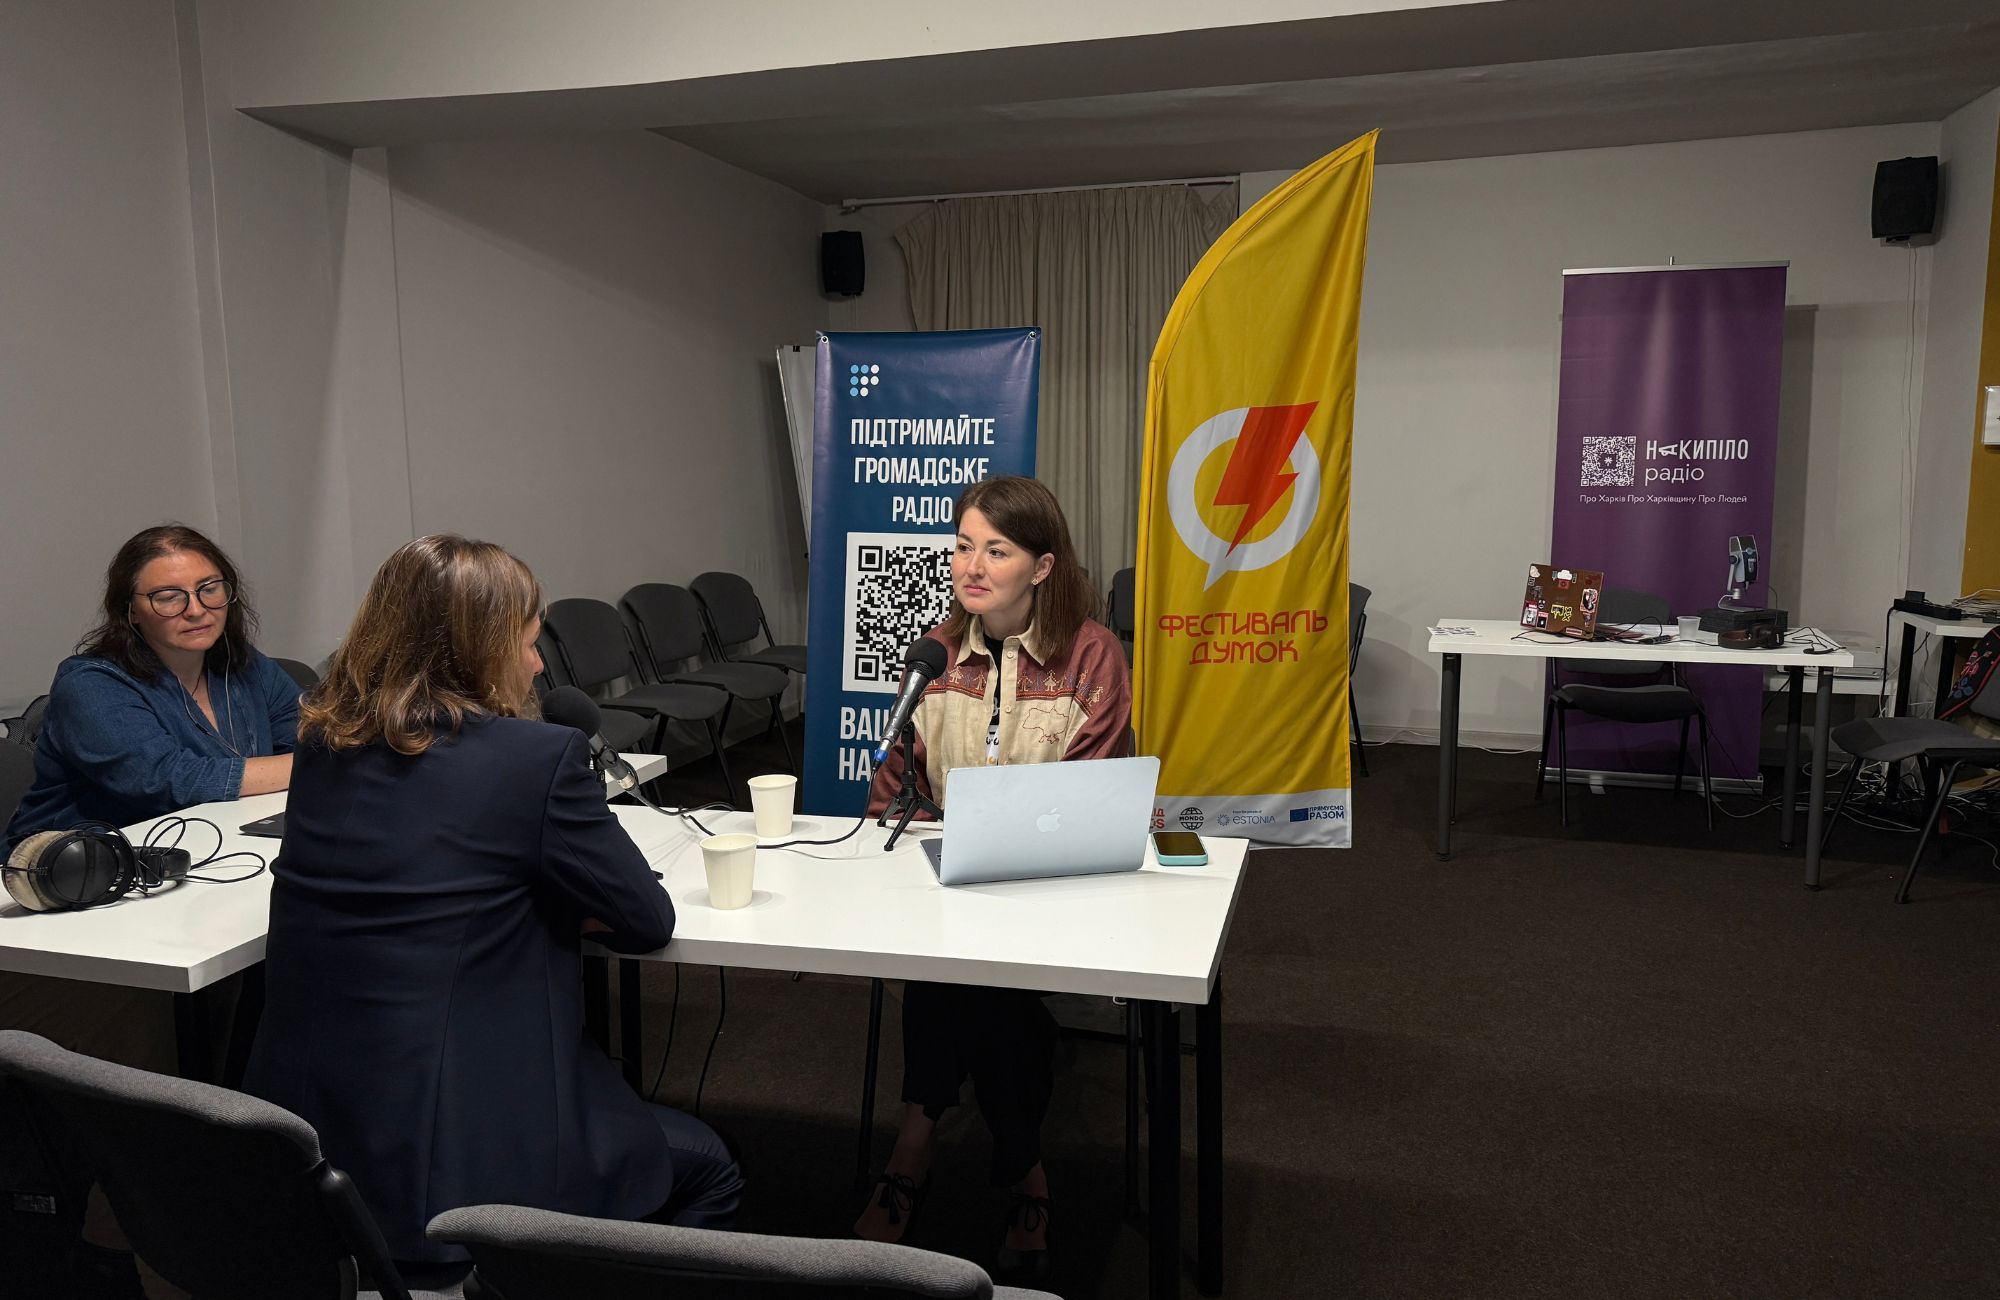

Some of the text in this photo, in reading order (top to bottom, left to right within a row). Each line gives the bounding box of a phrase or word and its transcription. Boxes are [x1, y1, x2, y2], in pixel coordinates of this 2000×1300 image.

[851, 414, 995, 447] ПІДТРИМАЙТЕ
[854, 457, 989, 486] ГРОМАДСЬКЕ
[1645, 463, 1704, 487] радіо
[892, 496, 953, 525] РАДІО
[1580, 494, 1747, 504] Про Харків Про Харківщину Про Людей
[1158, 609, 1329, 638] ФЕСТИВАЛЬ
[1189, 639, 1298, 665] ДУМОК
[1310, 811, 1345, 820] РАЗОМ
